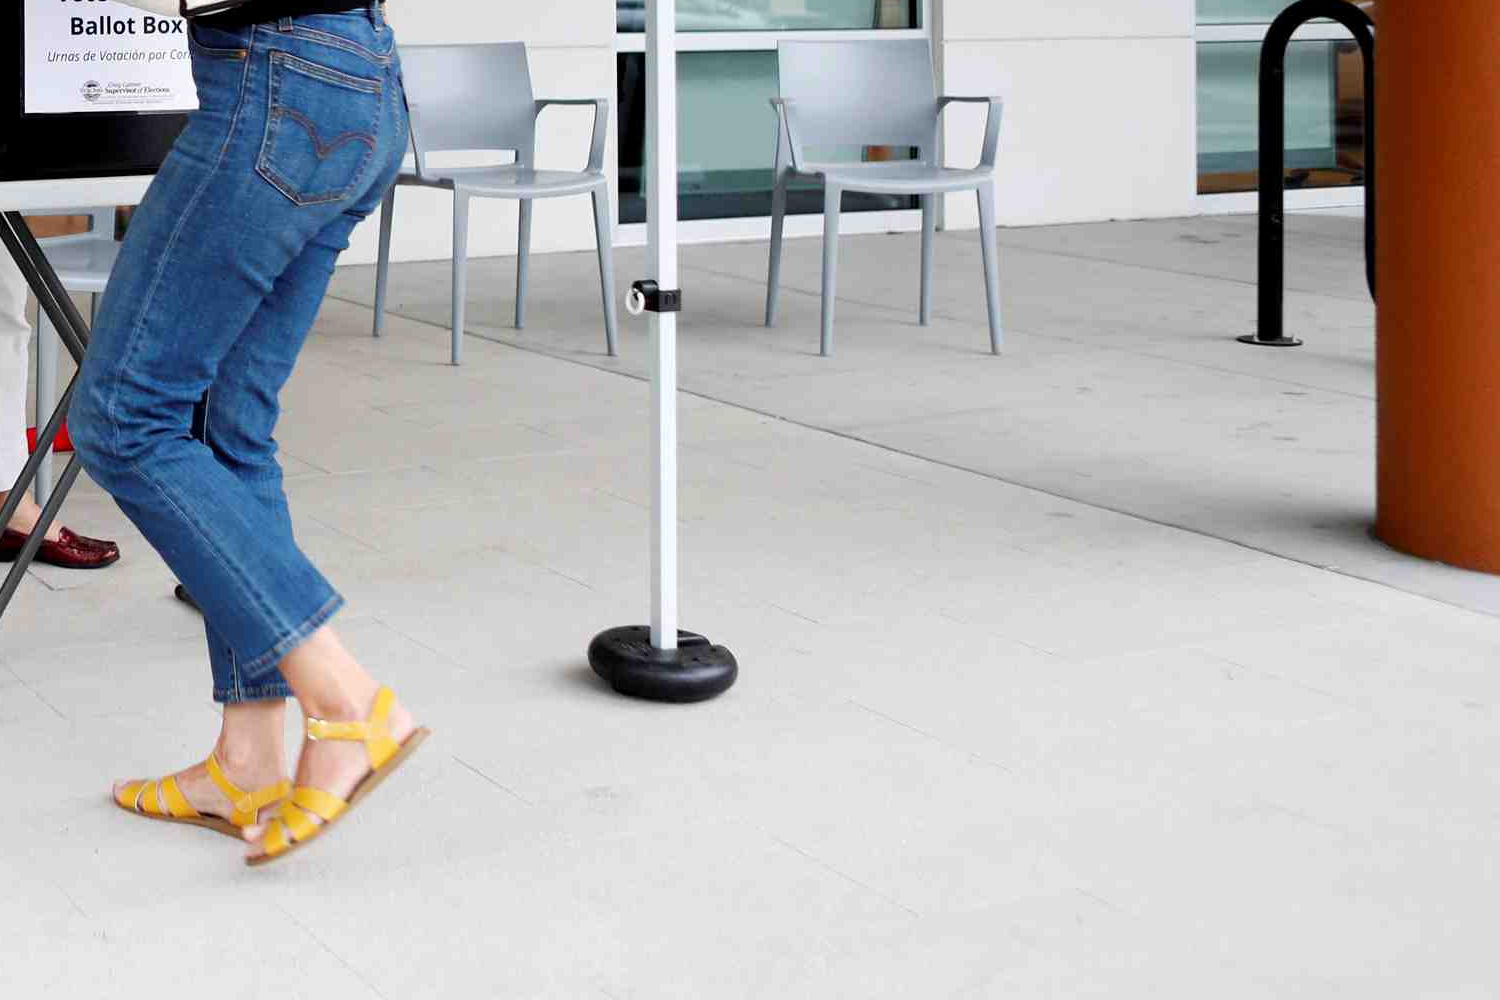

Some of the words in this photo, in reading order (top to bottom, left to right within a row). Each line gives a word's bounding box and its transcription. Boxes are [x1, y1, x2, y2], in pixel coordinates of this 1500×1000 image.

[70, 15, 137, 36] Ballot
[142, 15, 184, 35] Box
[46, 51, 80, 62] Urnas
[83, 50, 97, 62] de
[99, 49, 146, 62] Votación
[148, 52, 167, 65] por
